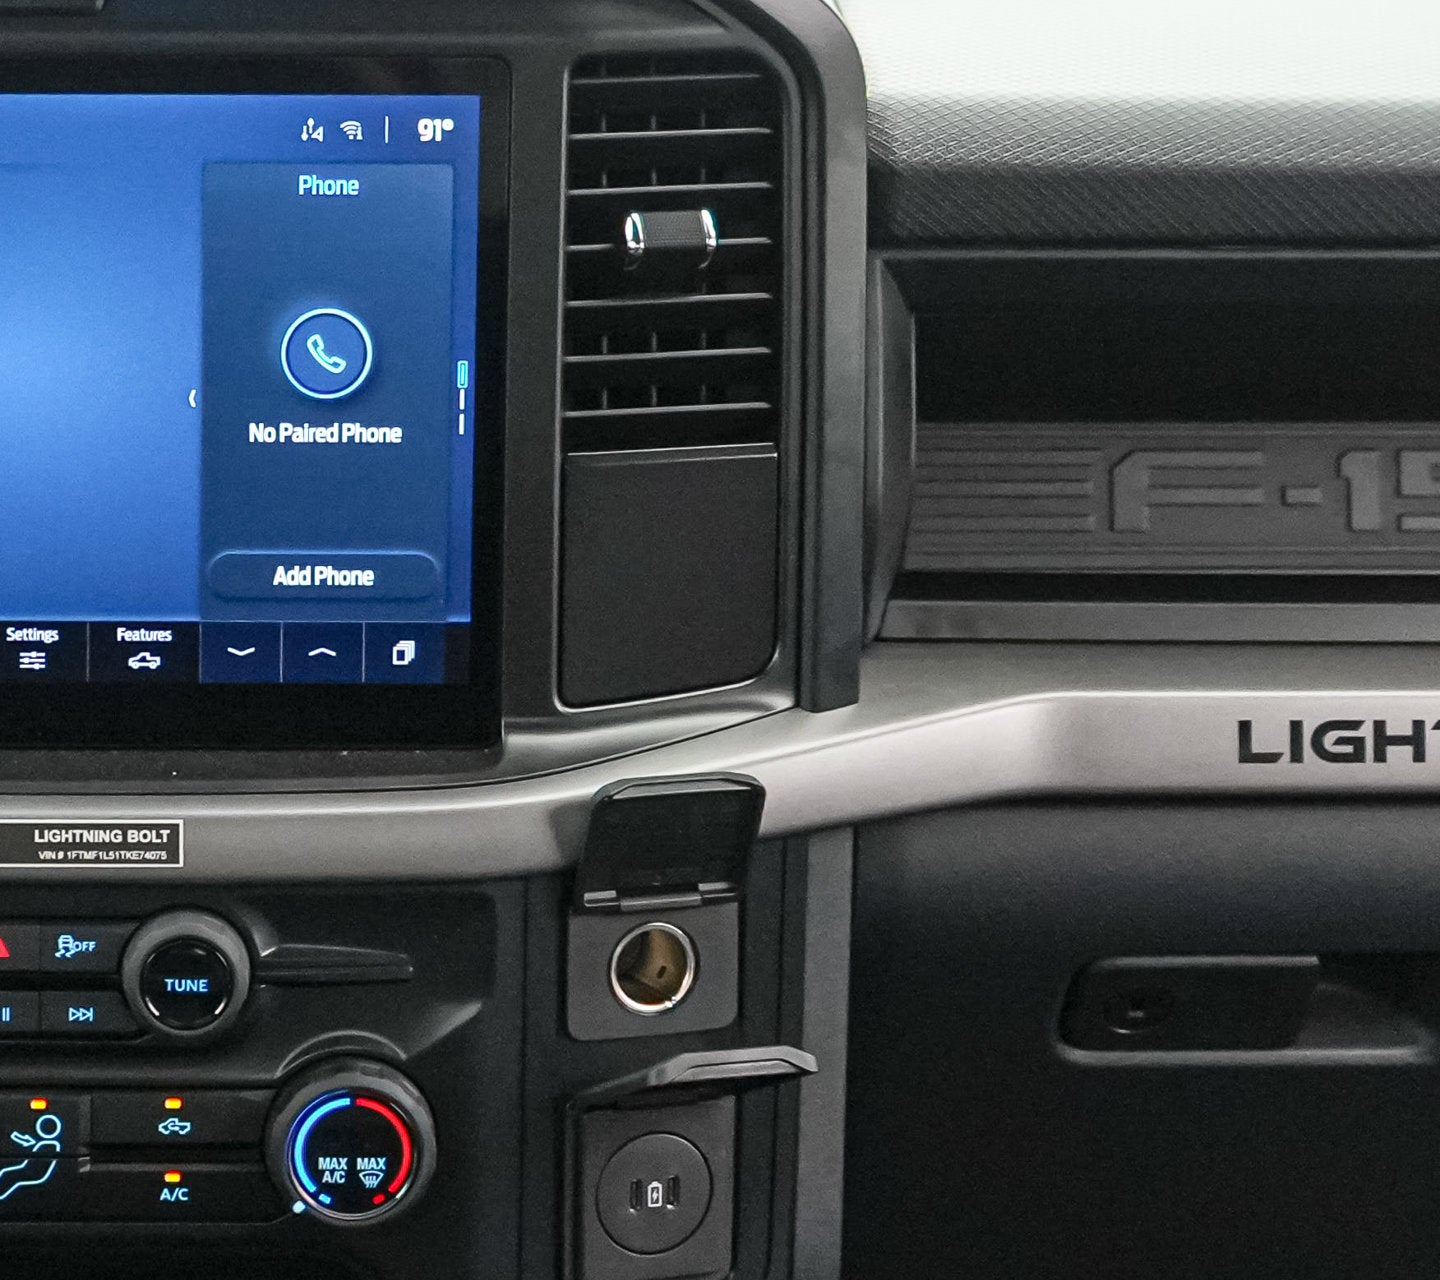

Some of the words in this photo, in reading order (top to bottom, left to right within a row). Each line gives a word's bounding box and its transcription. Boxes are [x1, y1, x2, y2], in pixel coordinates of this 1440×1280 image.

[417, 118, 455, 142] 91°
[298, 175, 359, 196] Phone
[248, 422, 276, 443] No
[279, 422, 340, 443] Paired
[341, 422, 403, 443] Phone
[272, 565, 311, 586] Add
[314, 565, 375, 586] Phone
[6, 627, 59, 643] Settings
[116, 627, 172, 642] Features
[34, 829, 123, 843] LIGHTNING
[127, 829, 170, 843] BOLT
[38, 850, 56, 860] VIN
[73, 940, 96, 953] OFF
[164, 978, 209, 993] TUNE
[318, 1157, 348, 1170] MAX
[356, 1157, 386, 1170] MAX
[322, 1170, 346, 1183] A/C
[160, 1187, 189, 1201] A/C
